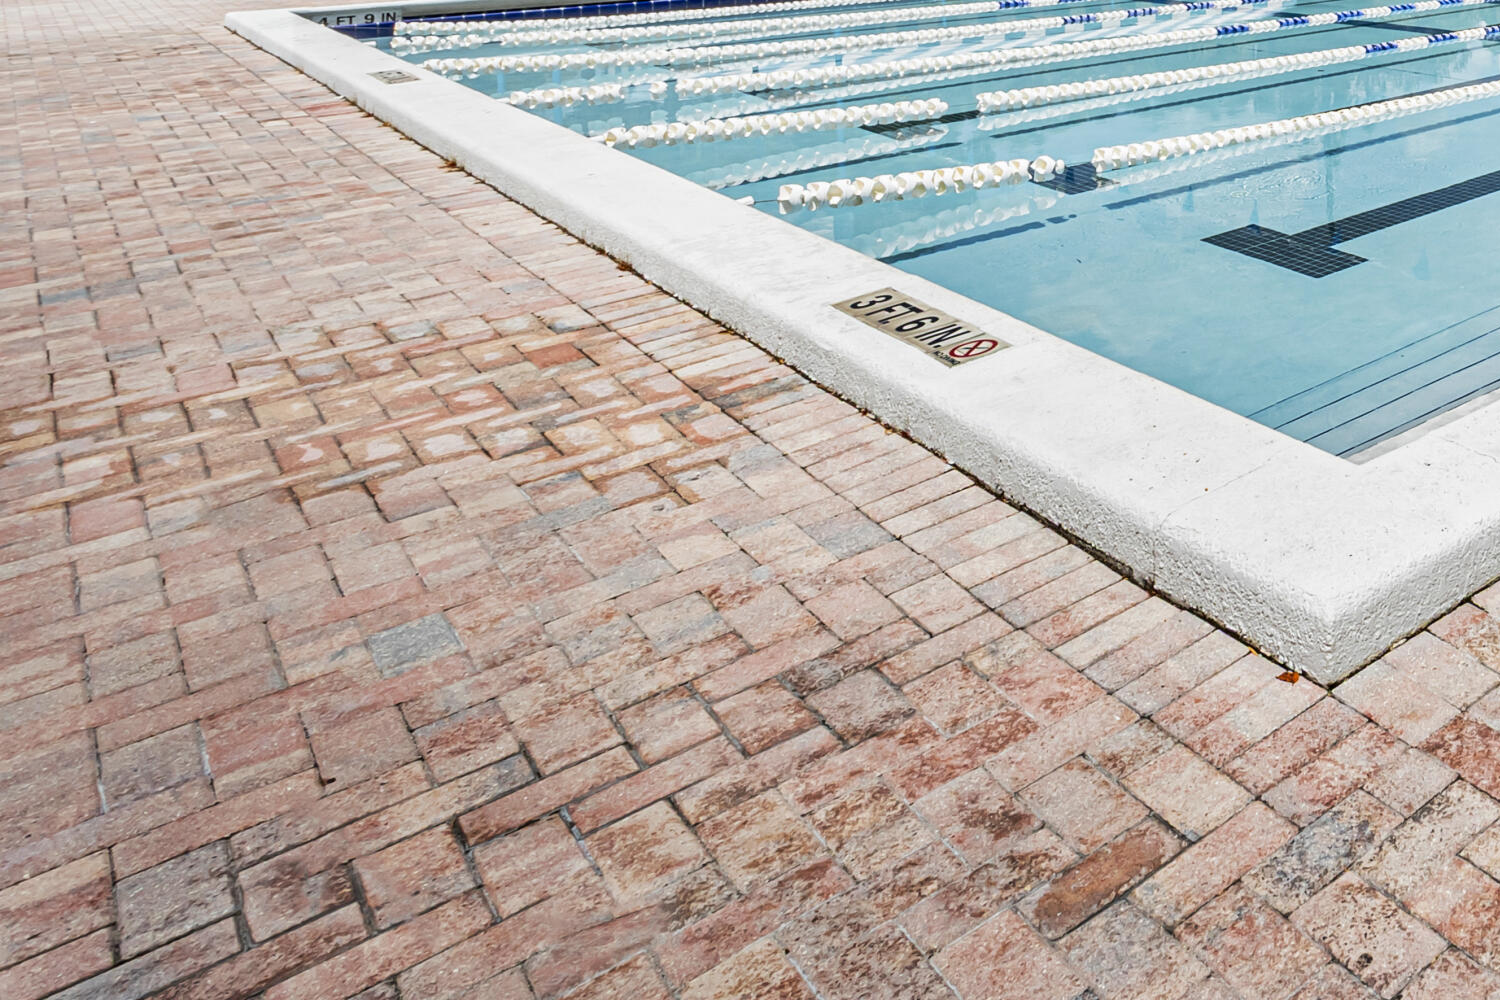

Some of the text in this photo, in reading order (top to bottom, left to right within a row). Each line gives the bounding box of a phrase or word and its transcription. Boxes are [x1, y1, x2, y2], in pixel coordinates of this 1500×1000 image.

[319, 12, 396, 26] 4 FT 9 IN
[850, 294, 893, 309] 3
[895, 316, 939, 332] 6
